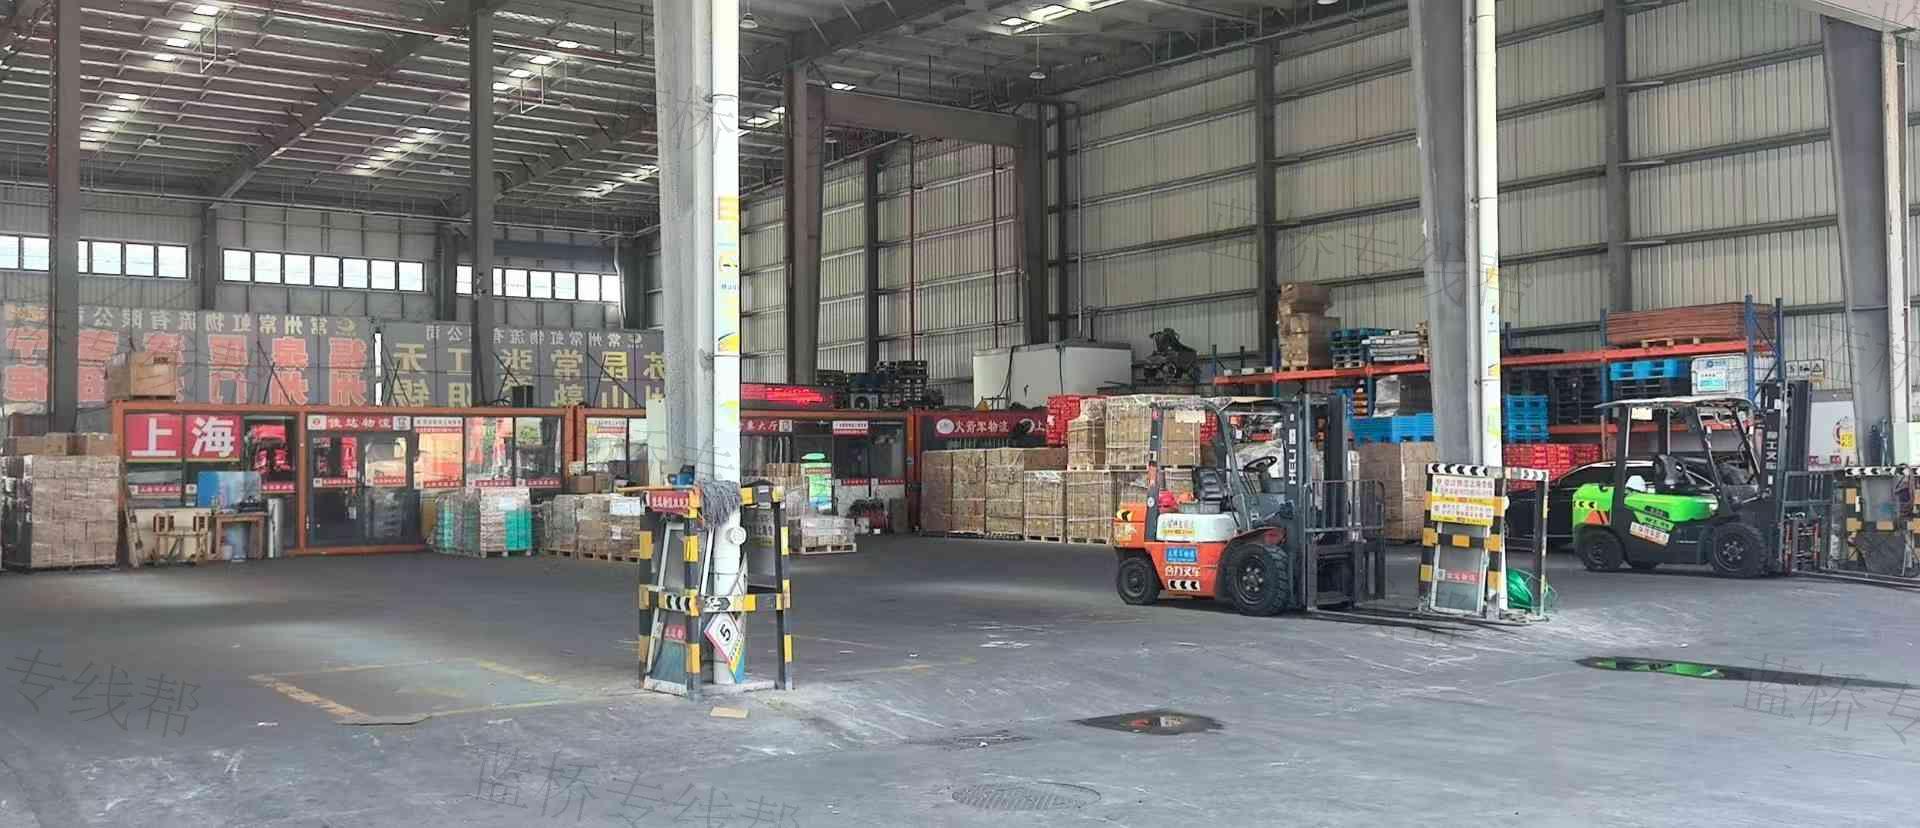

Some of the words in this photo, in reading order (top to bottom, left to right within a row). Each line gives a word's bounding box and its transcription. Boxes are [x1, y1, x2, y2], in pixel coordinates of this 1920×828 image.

[130, 416, 235, 457] 上海
[1288, 449, 1297, 485] HELI
[720, 624, 732, 642] 5
